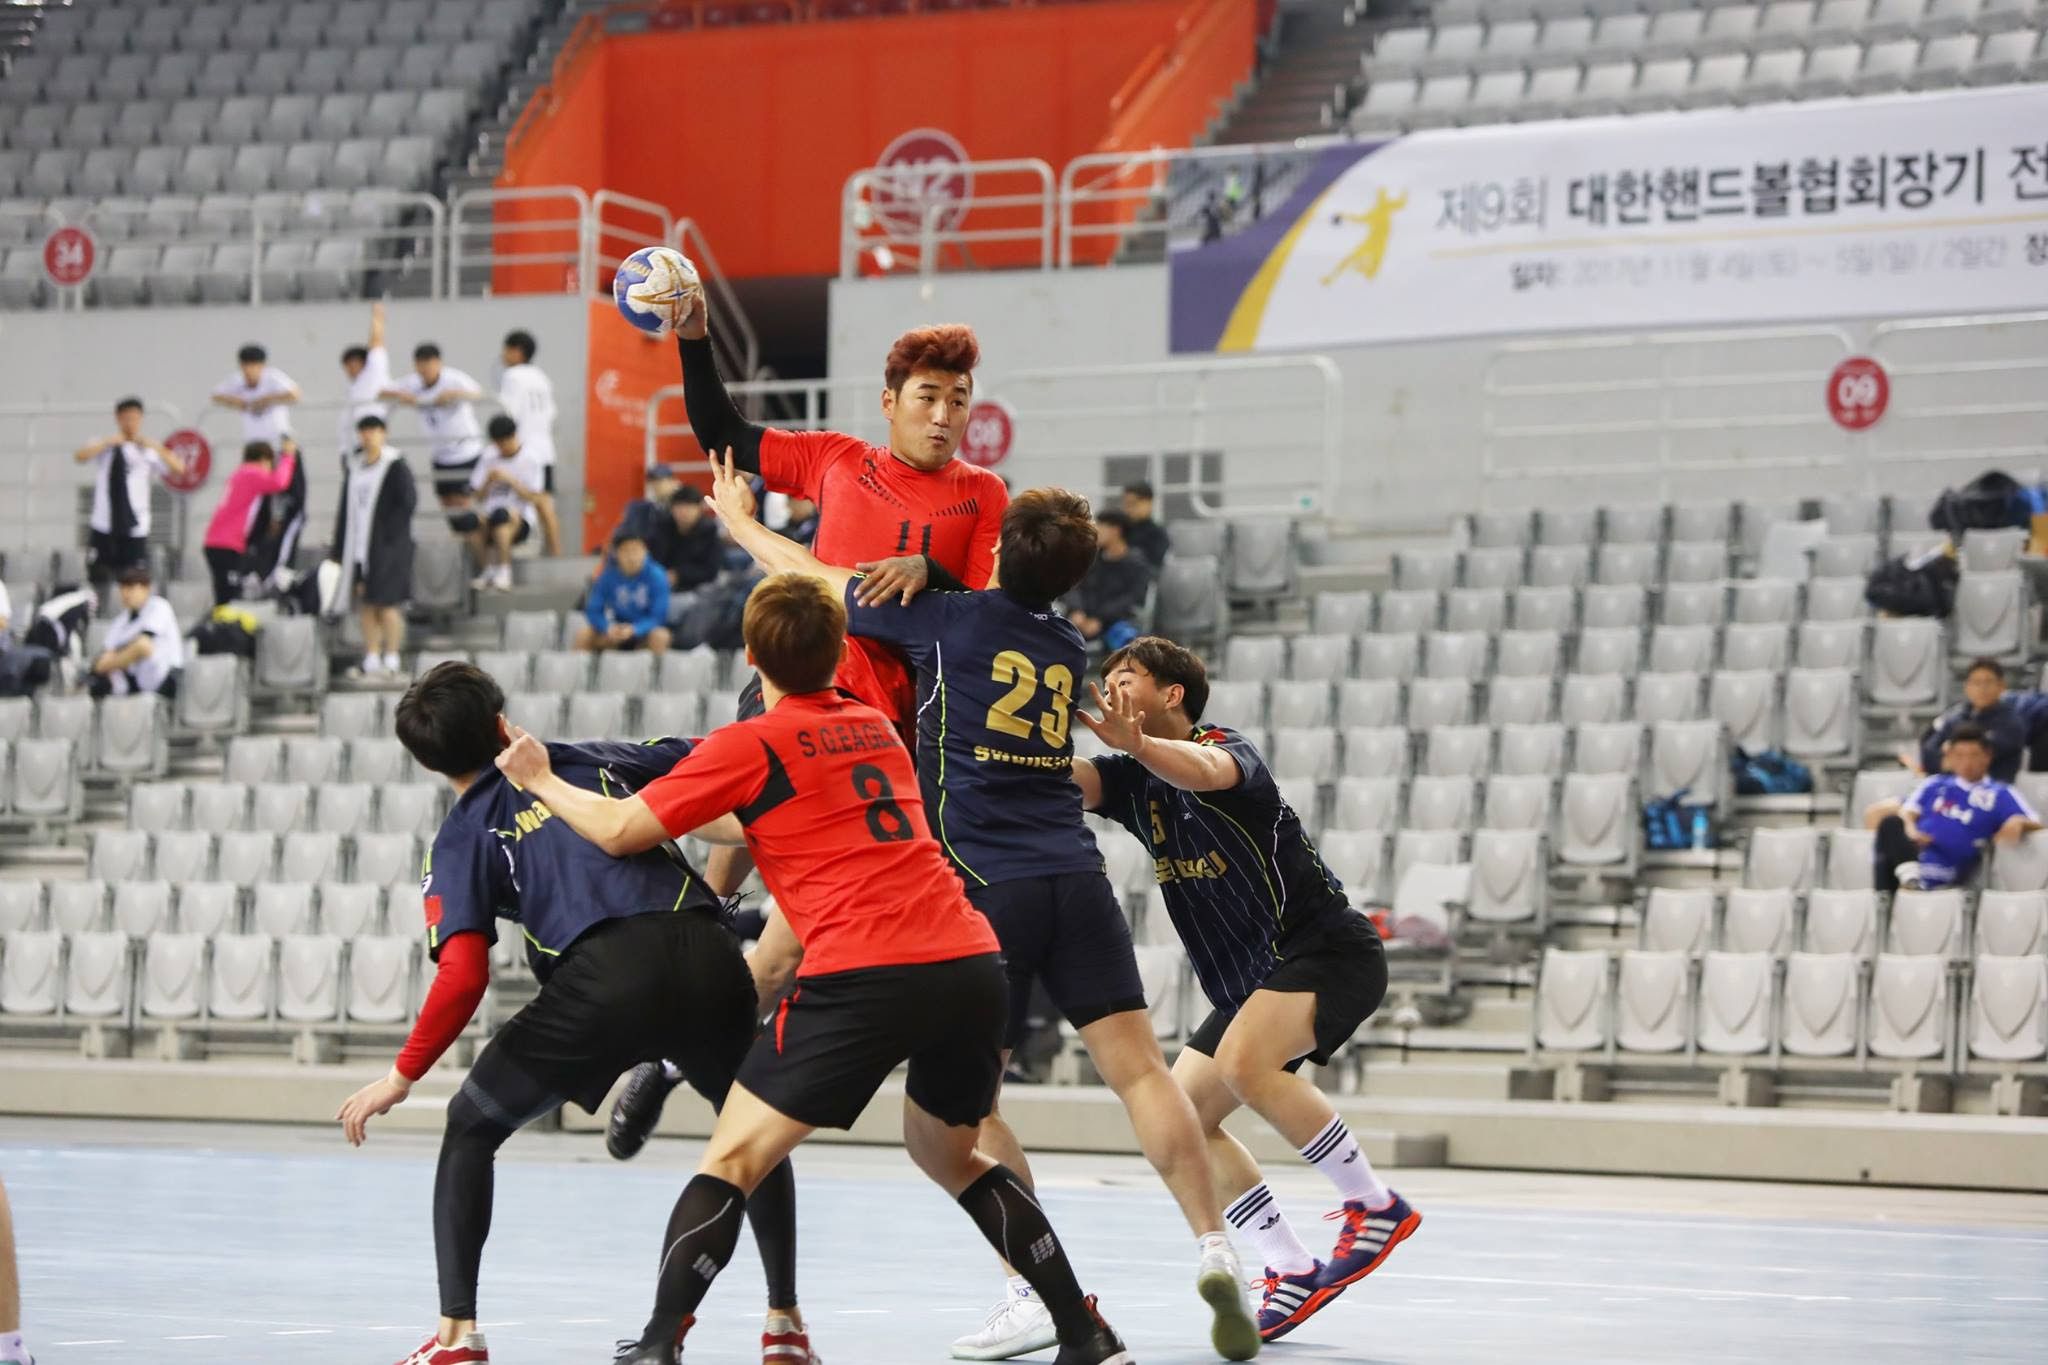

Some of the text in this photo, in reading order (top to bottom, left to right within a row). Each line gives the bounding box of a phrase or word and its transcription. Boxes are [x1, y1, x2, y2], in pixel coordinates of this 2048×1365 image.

[1435, 176, 1549, 234] 제9회
[1567, 146, 1986, 226] 대한핸드볼협회장기
[1838, 373, 1878, 408] 09
[896, 520, 932, 556] 11
[985, 650, 1074, 749] 23
[852, 764, 914, 842] 8
